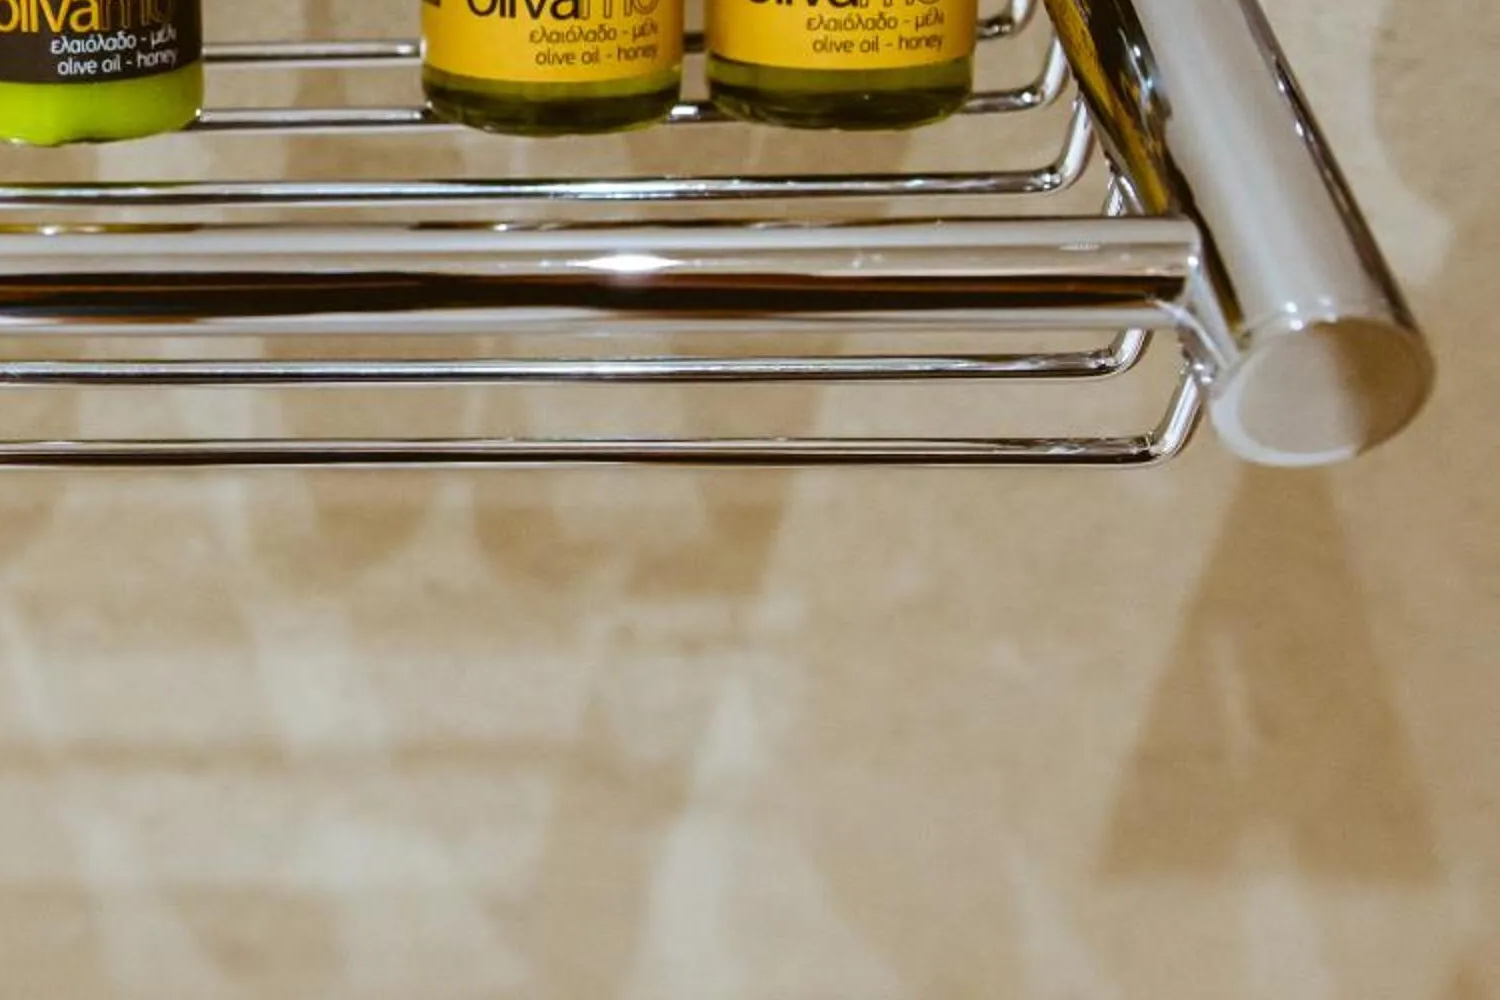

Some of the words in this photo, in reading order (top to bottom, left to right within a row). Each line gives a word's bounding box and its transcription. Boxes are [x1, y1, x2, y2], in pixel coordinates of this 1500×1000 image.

[806, 11, 898, 31] ελαιόλαδο
[51, 30, 137, 55] ελαιόλαδο
[812, 36, 855, 53] olive
[860, 35, 879, 53] oil
[898, 33, 944, 52] honey
[57, 58, 98, 76] olive
[102, 57, 121, 73] oil
[137, 49, 177, 69] honey
[535, 49, 575, 66] olive
[581, 47, 599, 64] oil
